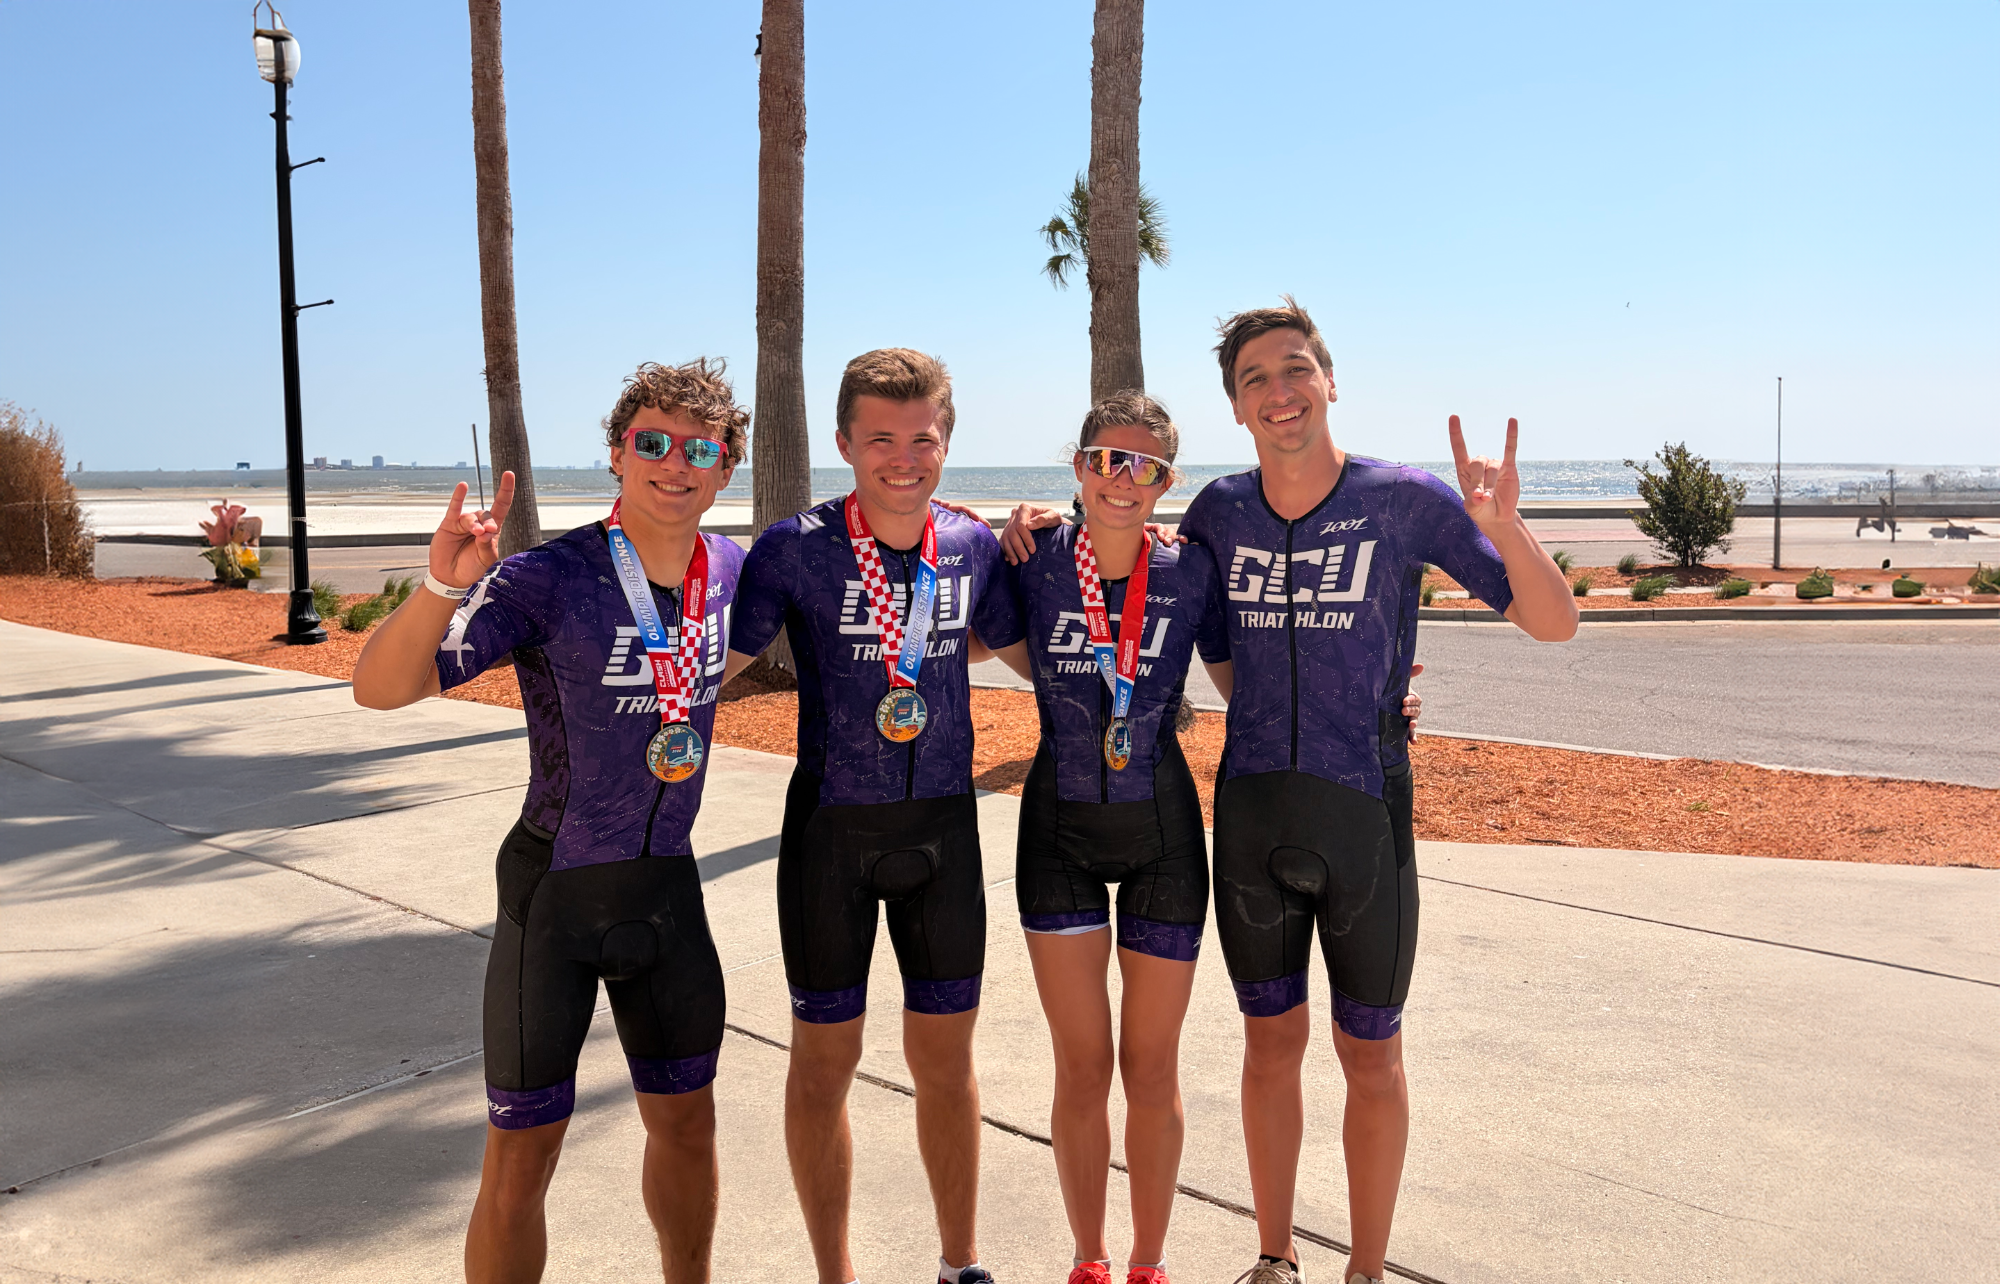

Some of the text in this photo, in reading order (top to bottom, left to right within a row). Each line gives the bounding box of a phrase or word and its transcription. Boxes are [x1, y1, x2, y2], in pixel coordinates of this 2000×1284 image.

[613, 535, 660, 641] OLYMPIC DISTANCE
[1228, 540, 1378, 604] GCU
[852, 638, 959, 661] TRILON
[905, 622, 923, 670] OLYMPIC
[916, 571, 931, 621] DISTANCE
[1238, 611, 1354, 630] TRIATHLON
